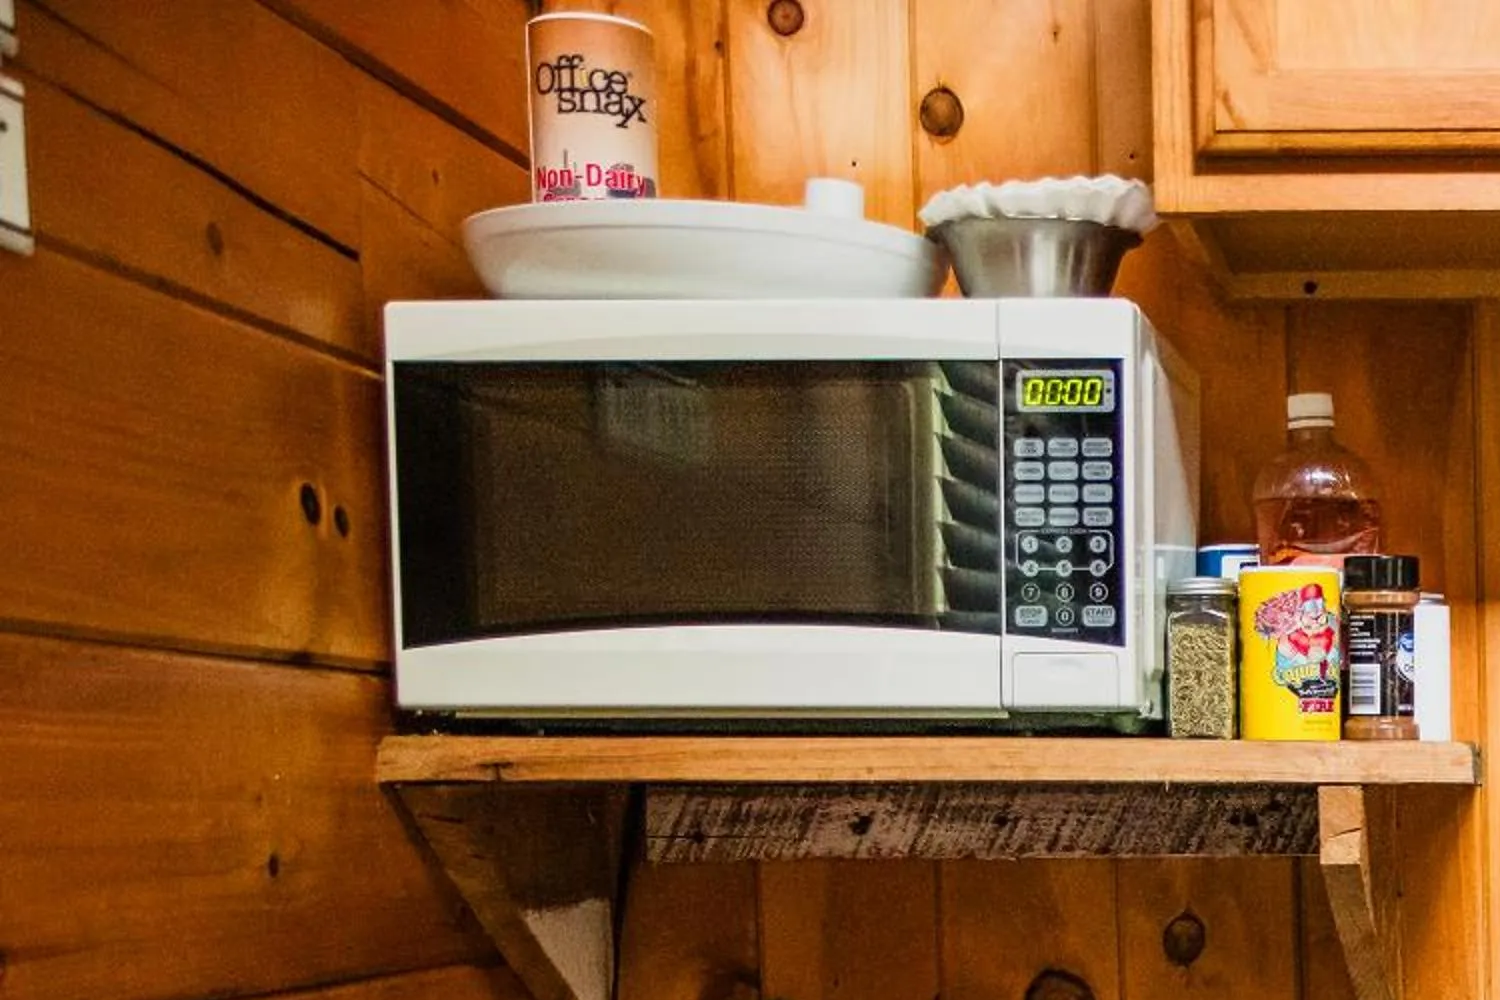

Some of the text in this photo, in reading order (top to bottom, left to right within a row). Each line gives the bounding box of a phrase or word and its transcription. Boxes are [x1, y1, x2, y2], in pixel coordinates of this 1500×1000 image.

[535, 54, 628, 95] Office
[556, 88, 648, 128] snax
[537, 163, 647, 196] Non-Dairy
